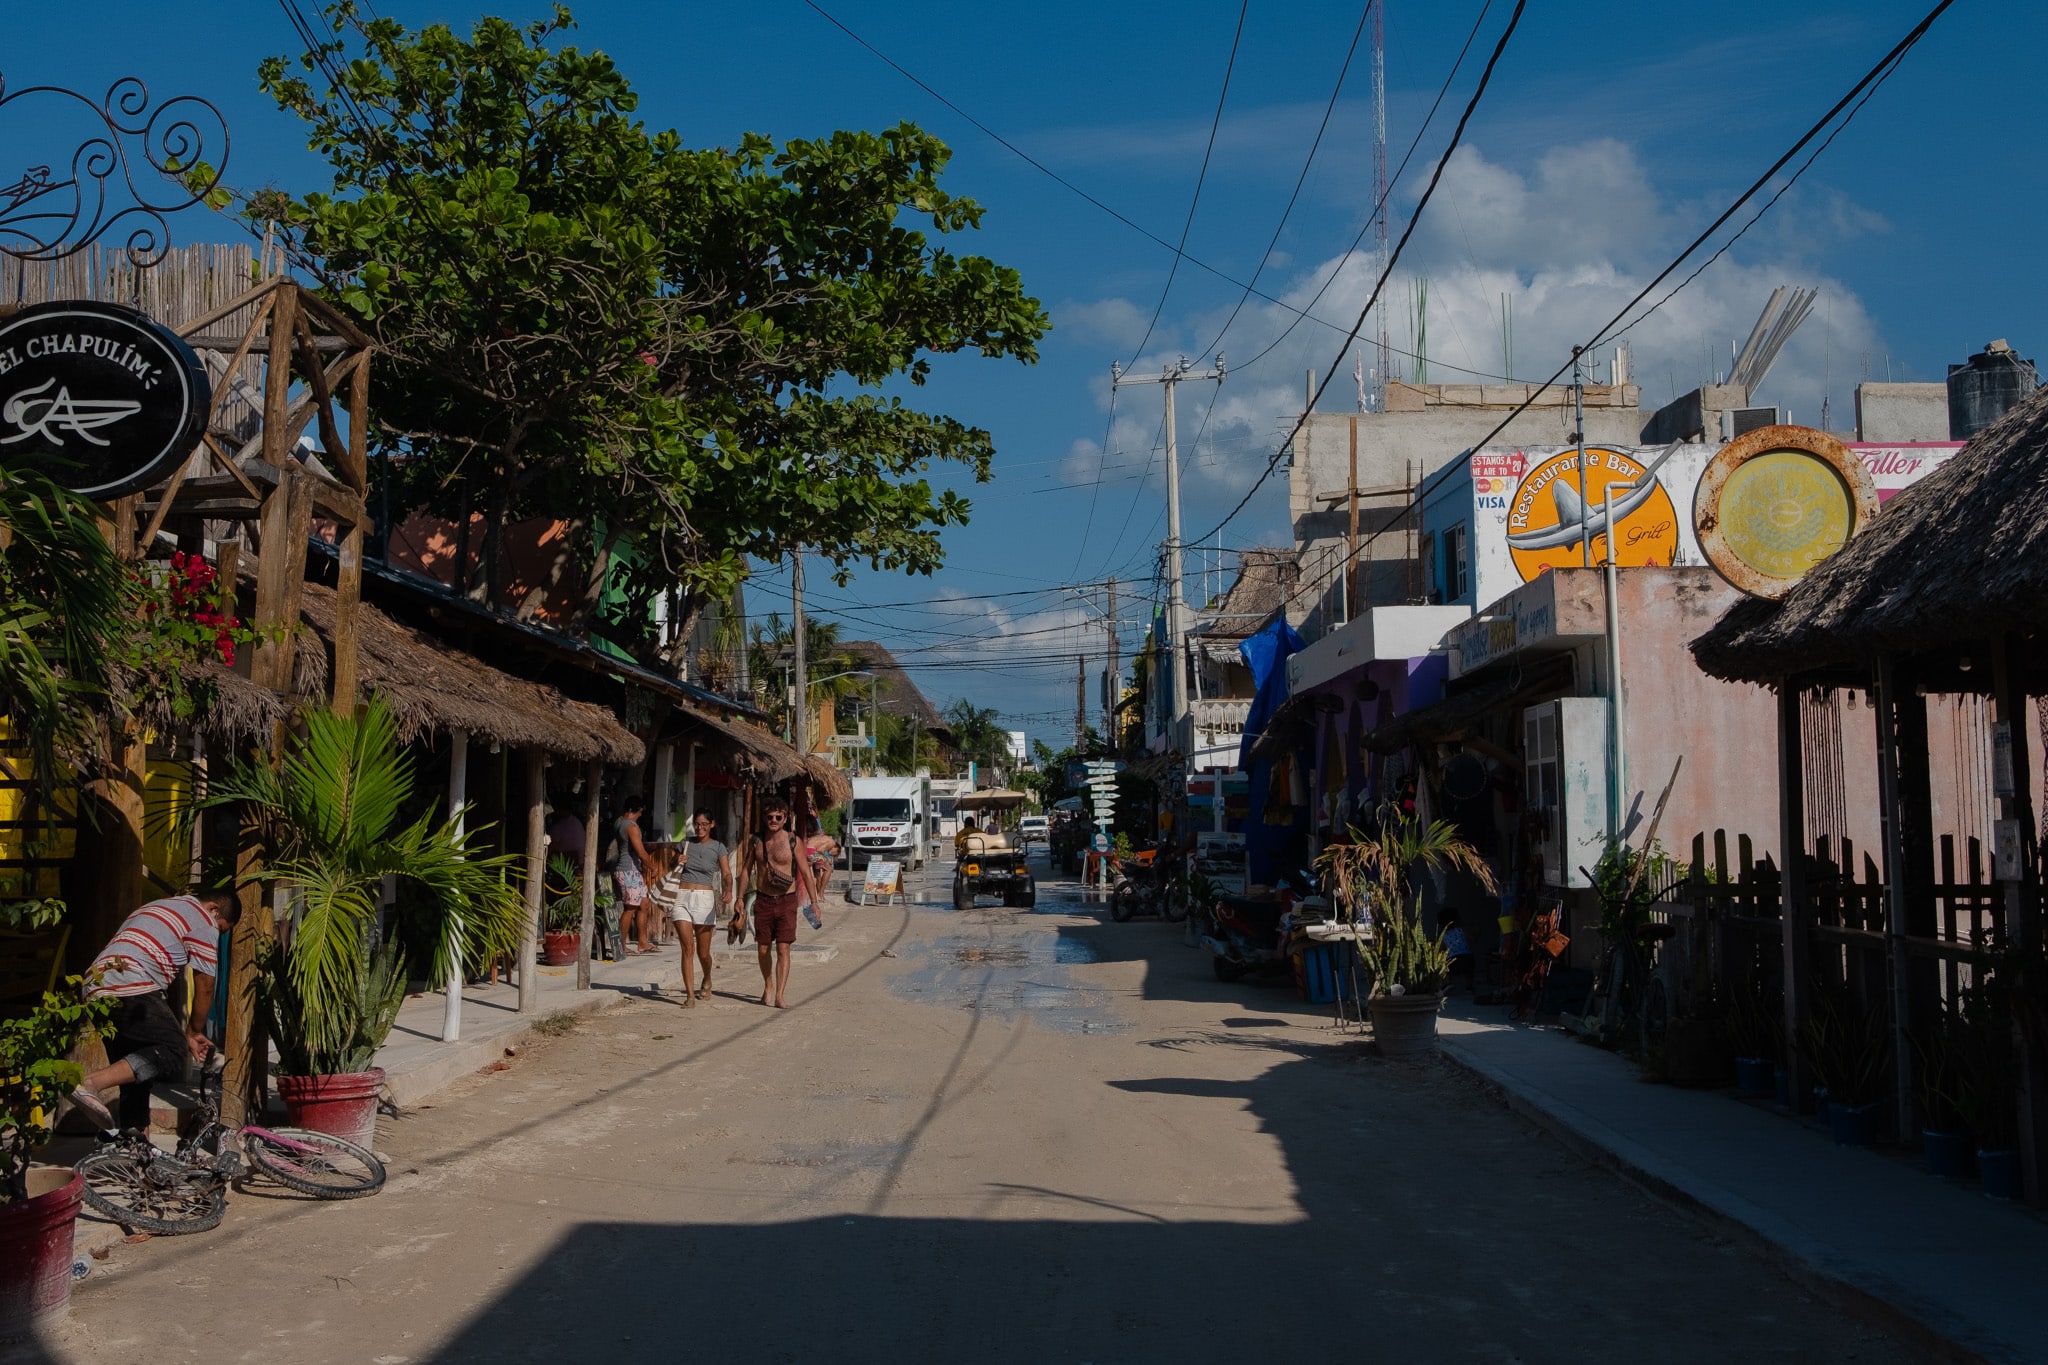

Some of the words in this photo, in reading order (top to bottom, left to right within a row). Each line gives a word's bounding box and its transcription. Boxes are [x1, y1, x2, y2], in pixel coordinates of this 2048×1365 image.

[1471, 456, 1505, 466] ESTAMOS
[1506, 457, 1512, 465] A
[1511, 451, 1600, 529] Restaurante
[1605, 454, 1640, 479] Bar
[1478, 496, 1506, 508] VISA
[1625, 520, 1671, 547] Grill
